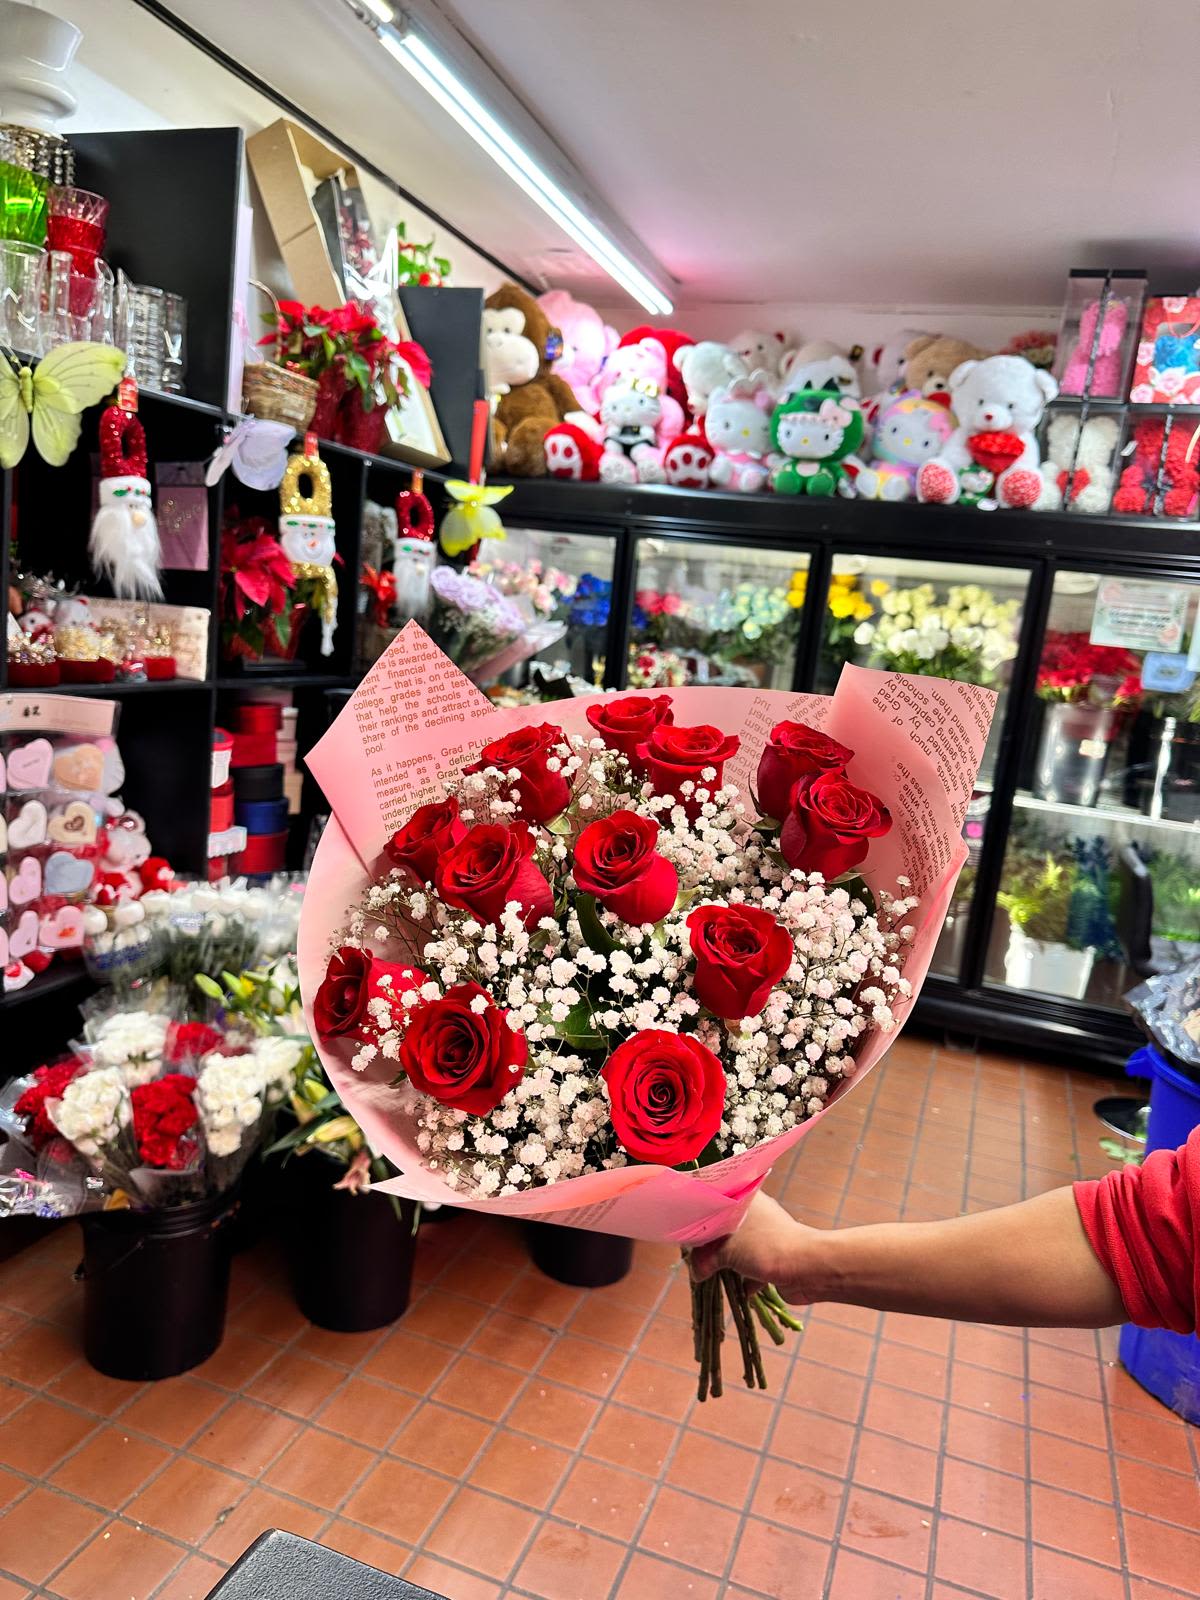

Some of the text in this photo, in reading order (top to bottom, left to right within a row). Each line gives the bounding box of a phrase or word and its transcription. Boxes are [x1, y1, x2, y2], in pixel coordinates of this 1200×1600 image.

[388, 659, 396, 667] is
[398, 650, 438, 666] awarded
[413, 642, 428, 651] the
[387, 664, 426, 679] financial
[394, 678, 412, 690] that
[415, 676, 426, 685] is,
[428, 673, 441, 682] on
[443, 669, 463, 679] data
[353, 678, 469, 711] college grades and test
[877, 688, 901, 711] Grad
[894, 673, 930, 706] schools
[957, 685, 976, 712] have
[985, 690, 996, 708] out
[355, 711, 373, 722] that
[379, 705, 398, 717] help
[404, 700, 419, 710] the
[427, 691, 461, 705] schools
[359, 721, 378, 733] their
[381, 712, 418, 727] rankings
[421, 706, 438, 718] and
[442, 699, 471, 713] attract
[473, 698, 480, 706] a
[872, 696, 888, 713] the
[932, 707, 946, 725] the
[362, 732, 386, 745] share
[391, 726, 400, 736] of
[404, 723, 420, 733] the
[424, 713, 465, 728] declining
[890, 716, 904, 726] of
[908, 715, 922, 730] by
[931, 687, 978, 768] who attend them.
[884, 679, 970, 802] loans is getting captured by
[909, 730, 932, 757] much
[947, 727, 968, 764] operate
[371, 767, 382, 778] As
[386, 763, 393, 773] it
[396, 752, 436, 770] happens,
[440, 744, 463, 757] Grad
[926, 735, 960, 792] represented
[373, 769, 409, 788] intended
[416, 766, 427, 775] as
[434, 762, 441, 770] a
[376, 767, 459, 800] measure, as Grad
[936, 761, 951, 795] words,
[379, 793, 408, 810] carried
[410, 785, 437, 800] higher
[898, 790, 921, 830] reforms,
[902, 784, 920, 810] while
[384, 820, 403, 832] help
[896, 762, 946, 870] charge more or less the
[905, 820, 913, 831] to
[920, 810, 932, 838] ones,
[951, 802, 961, 828] other
[919, 834, 931, 861] delay
[929, 840, 940, 877] modest
